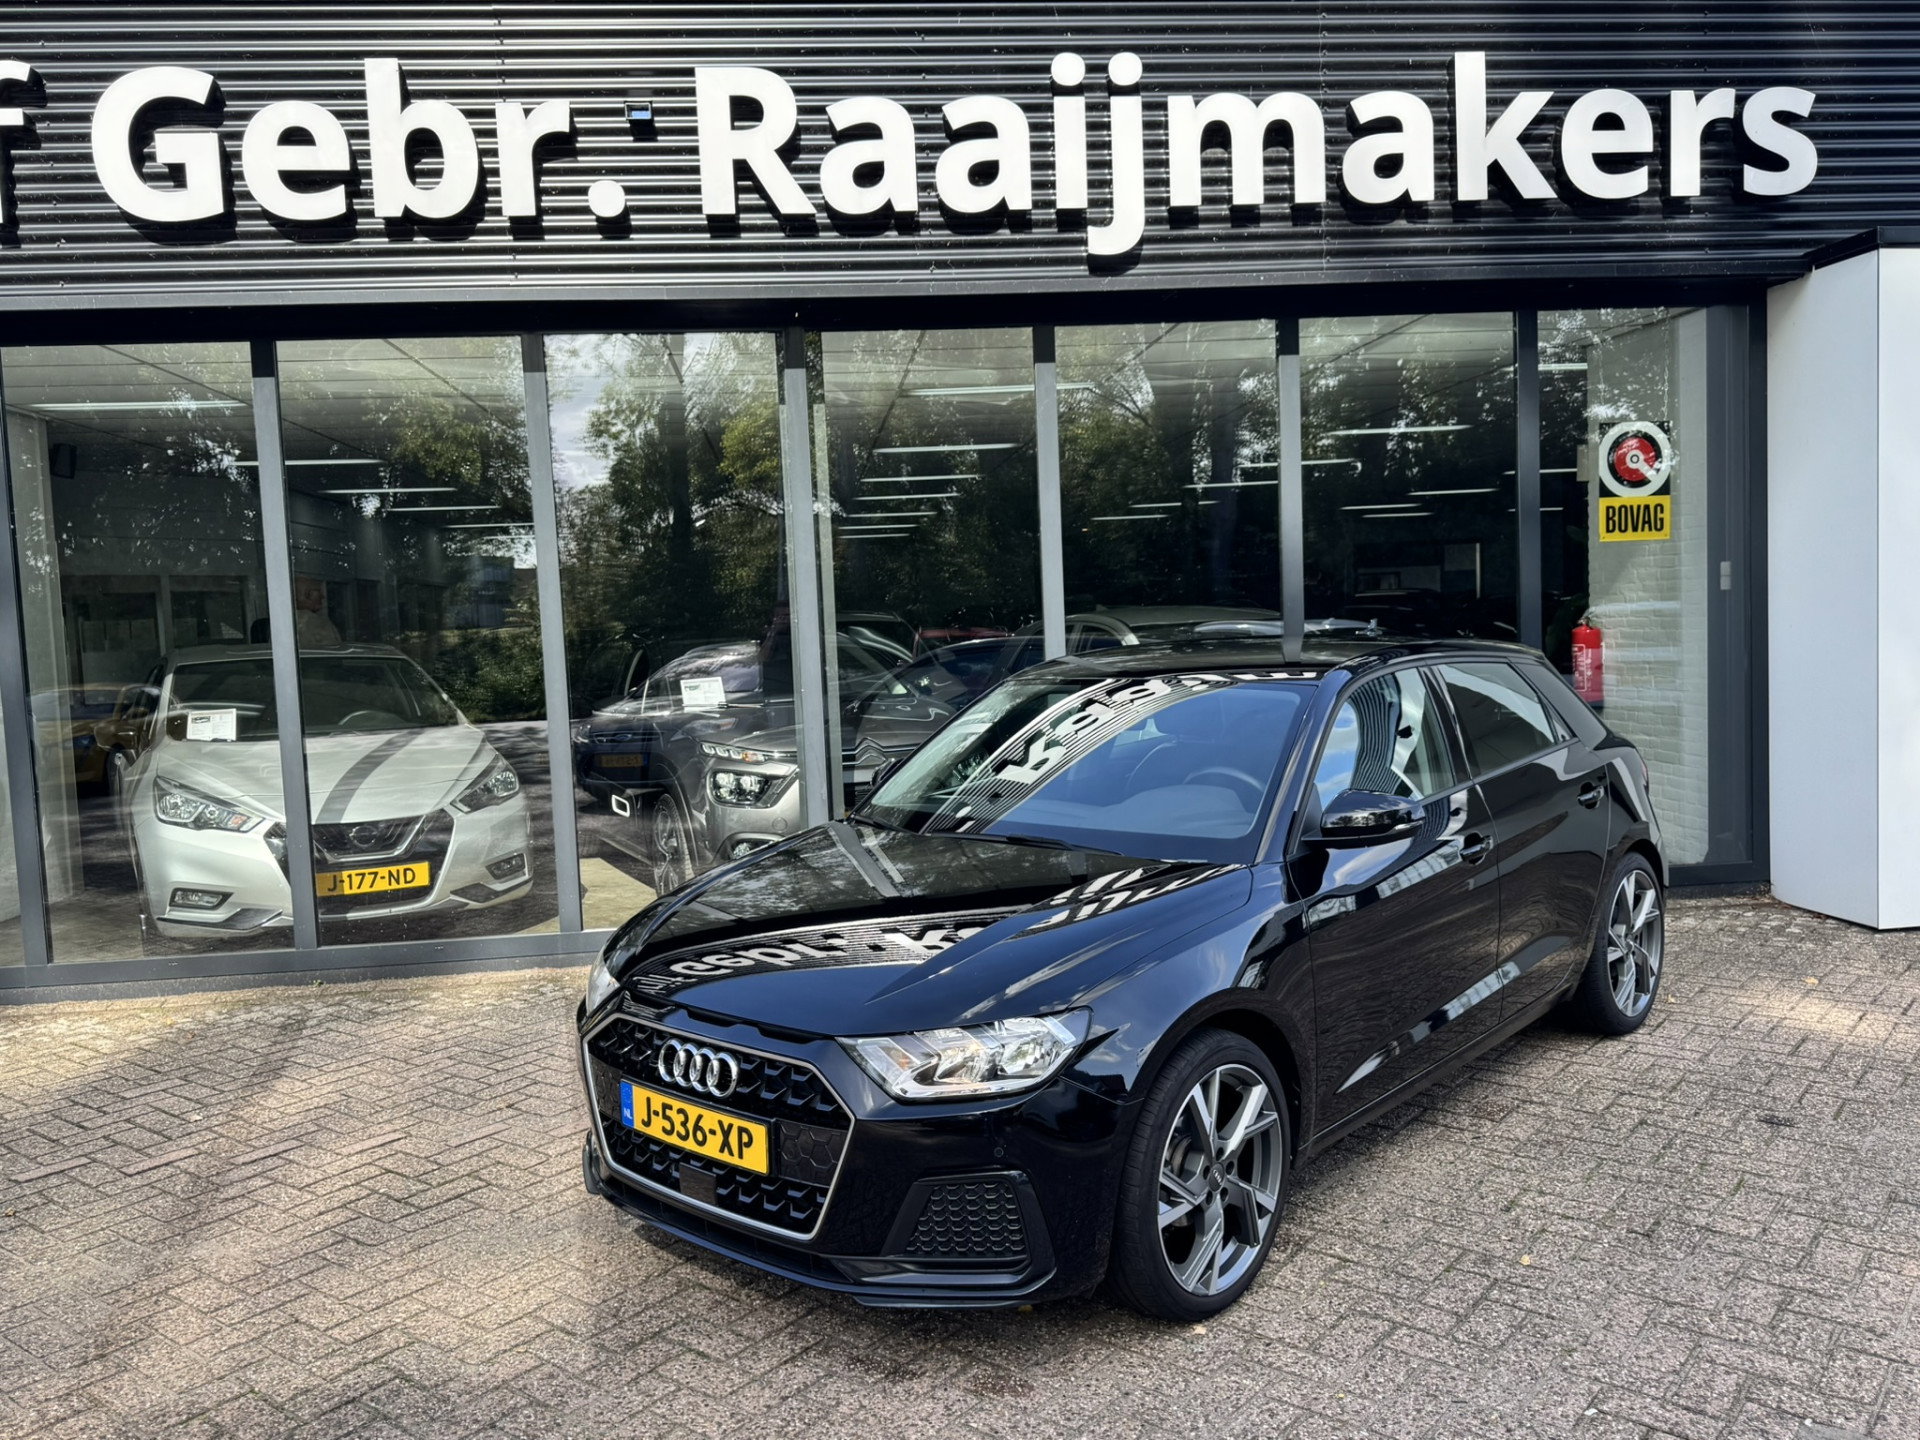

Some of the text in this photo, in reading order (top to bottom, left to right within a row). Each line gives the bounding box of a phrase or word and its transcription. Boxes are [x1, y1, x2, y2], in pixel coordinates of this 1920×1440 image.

[91, 58, 624, 222] Gebr.
[694, 51, 1818, 256] Raaijmakers
[1606, 503, 1664, 533] BOVAG
[327, 867, 416, 892] J-177-ND
[641, 1096, 754, 1160] J-536-XP
